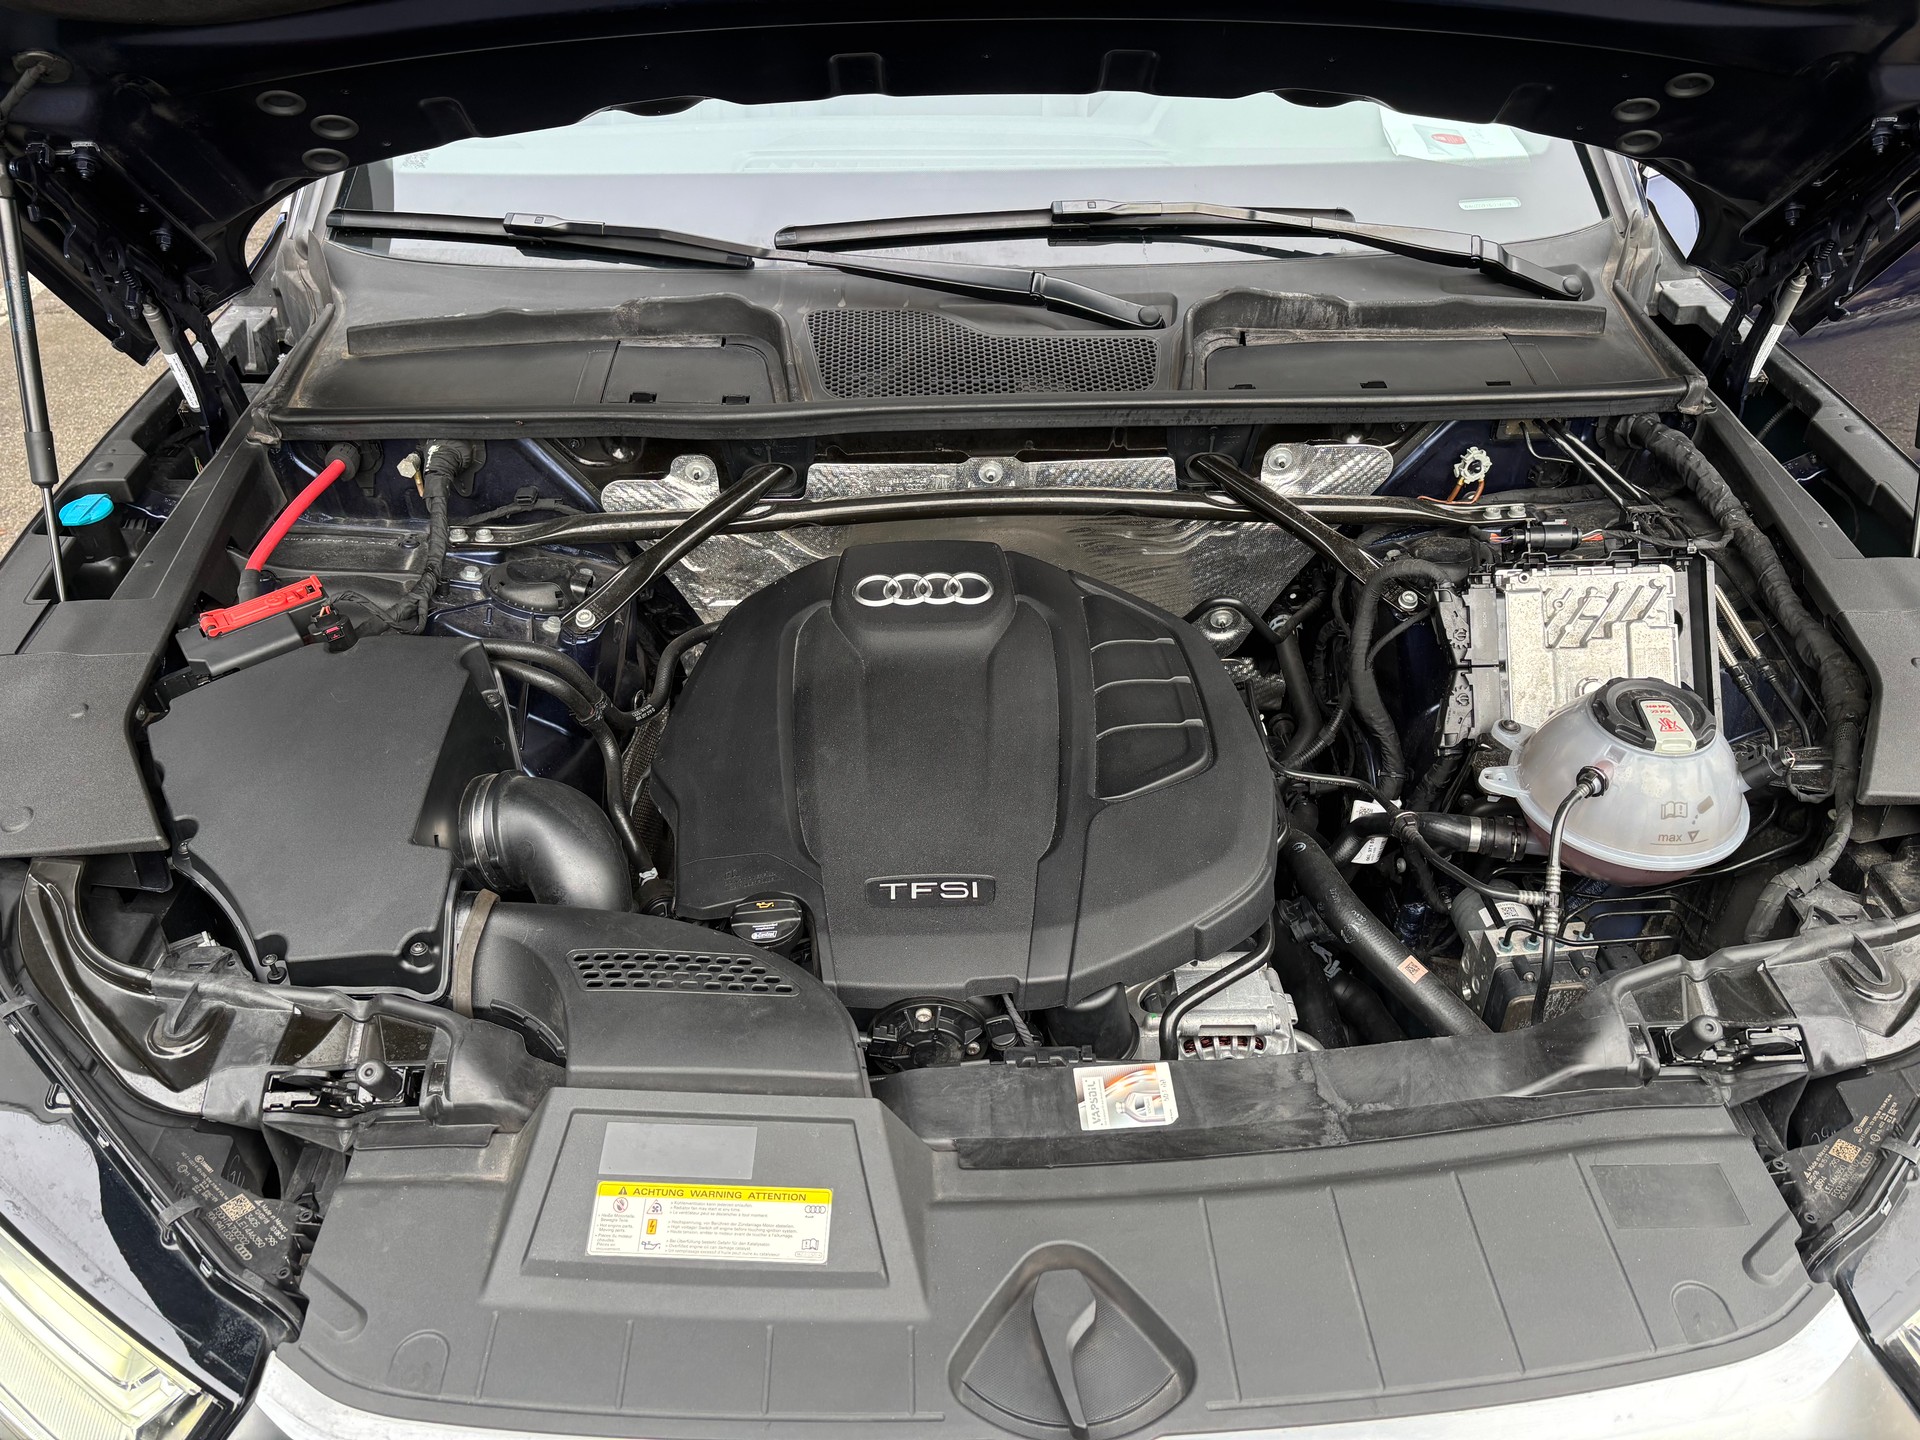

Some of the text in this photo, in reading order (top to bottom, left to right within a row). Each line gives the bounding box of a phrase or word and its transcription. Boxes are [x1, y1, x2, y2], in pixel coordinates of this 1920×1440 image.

[1658, 832, 1682, 842] max
[879, 881, 978, 900] TFSI
[633, 1187, 807, 1201] ACHTUNG WARNING ATTENTION
